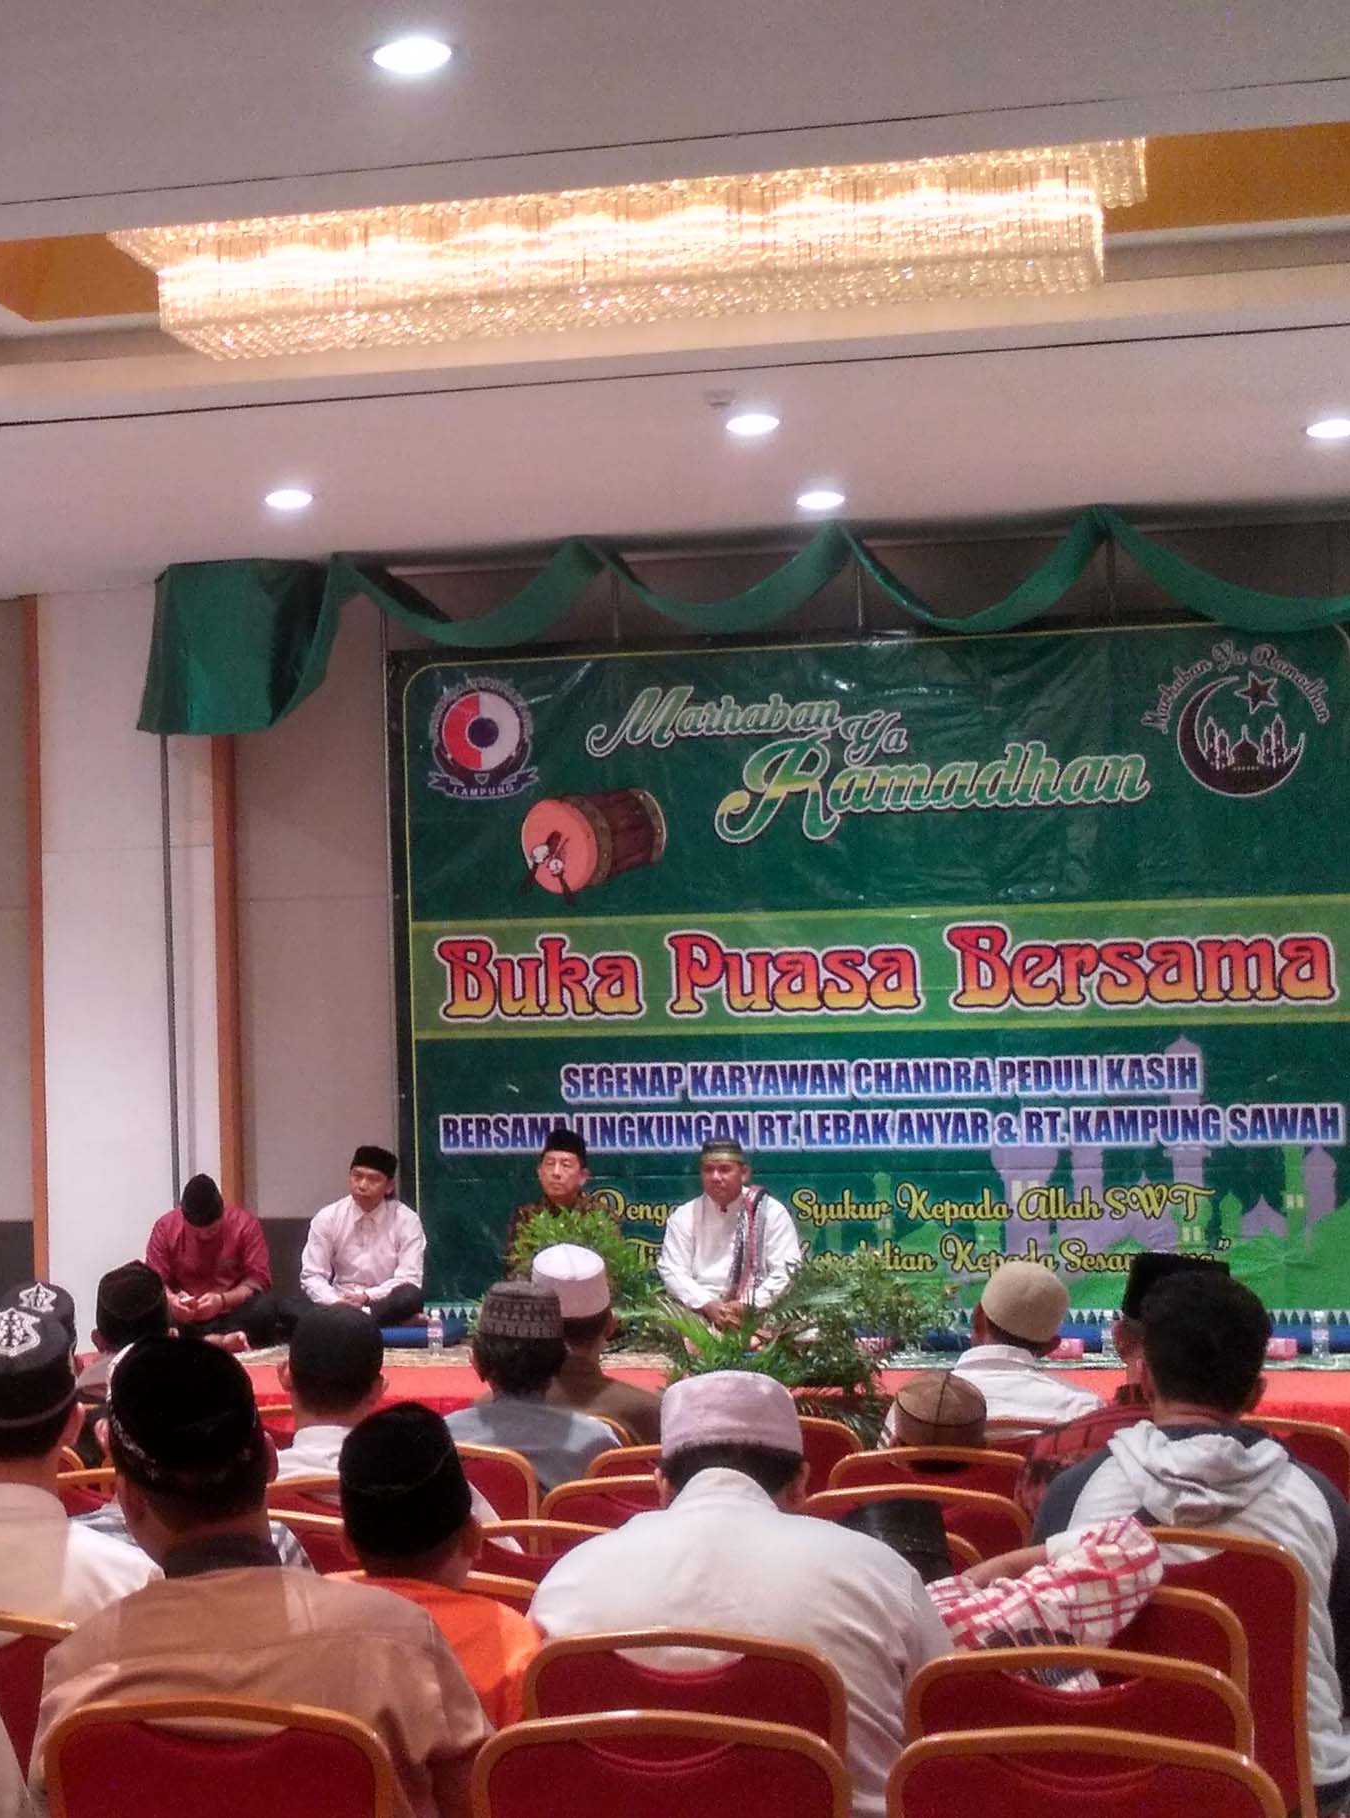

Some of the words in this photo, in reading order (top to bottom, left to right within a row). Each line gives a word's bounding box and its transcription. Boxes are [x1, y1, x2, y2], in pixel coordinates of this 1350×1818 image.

[586, 686, 843, 757] Marhaban
[839, 709, 908, 767] Ya
[714, 732, 1151, 843] Ramadhan
[434, 933, 646, 1022] Buka
[664, 930, 926, 1018] Puasa
[943, 920, 1340, 1013] Bersama
[561, 1063, 684, 1104] SEGENAP
[687, 1060, 850, 1101] KARYAWAN
[851, 1058, 992, 1099] CHANDRA
[995, 1055, 1100, 1096] PEDULI
[1103, 1053, 1204, 1095] KASIH
[439, 1112, 572, 1154] BERSAMA
[574, 1110, 753, 1152] LINGKUNGAN
[754, 1111, 801, 1149] RT.
[802, 1109, 893, 1148] LEBAK
[894, 1107, 992, 1147] ANYAR
[994, 1112, 1019, 1146] &
[1021, 1105, 1068, 1145] RT.
[1070, 1104, 1224, 1145] KAMPUNG
[1226, 1102, 1345, 1145] SAWAH
[792, 1188, 892, 1226] Syukur
[896, 1182, 1013, 1227] Kepada
[1017, 1186, 1104, 1221] Allah
[1105, 1182, 1216, 1222] SWT
